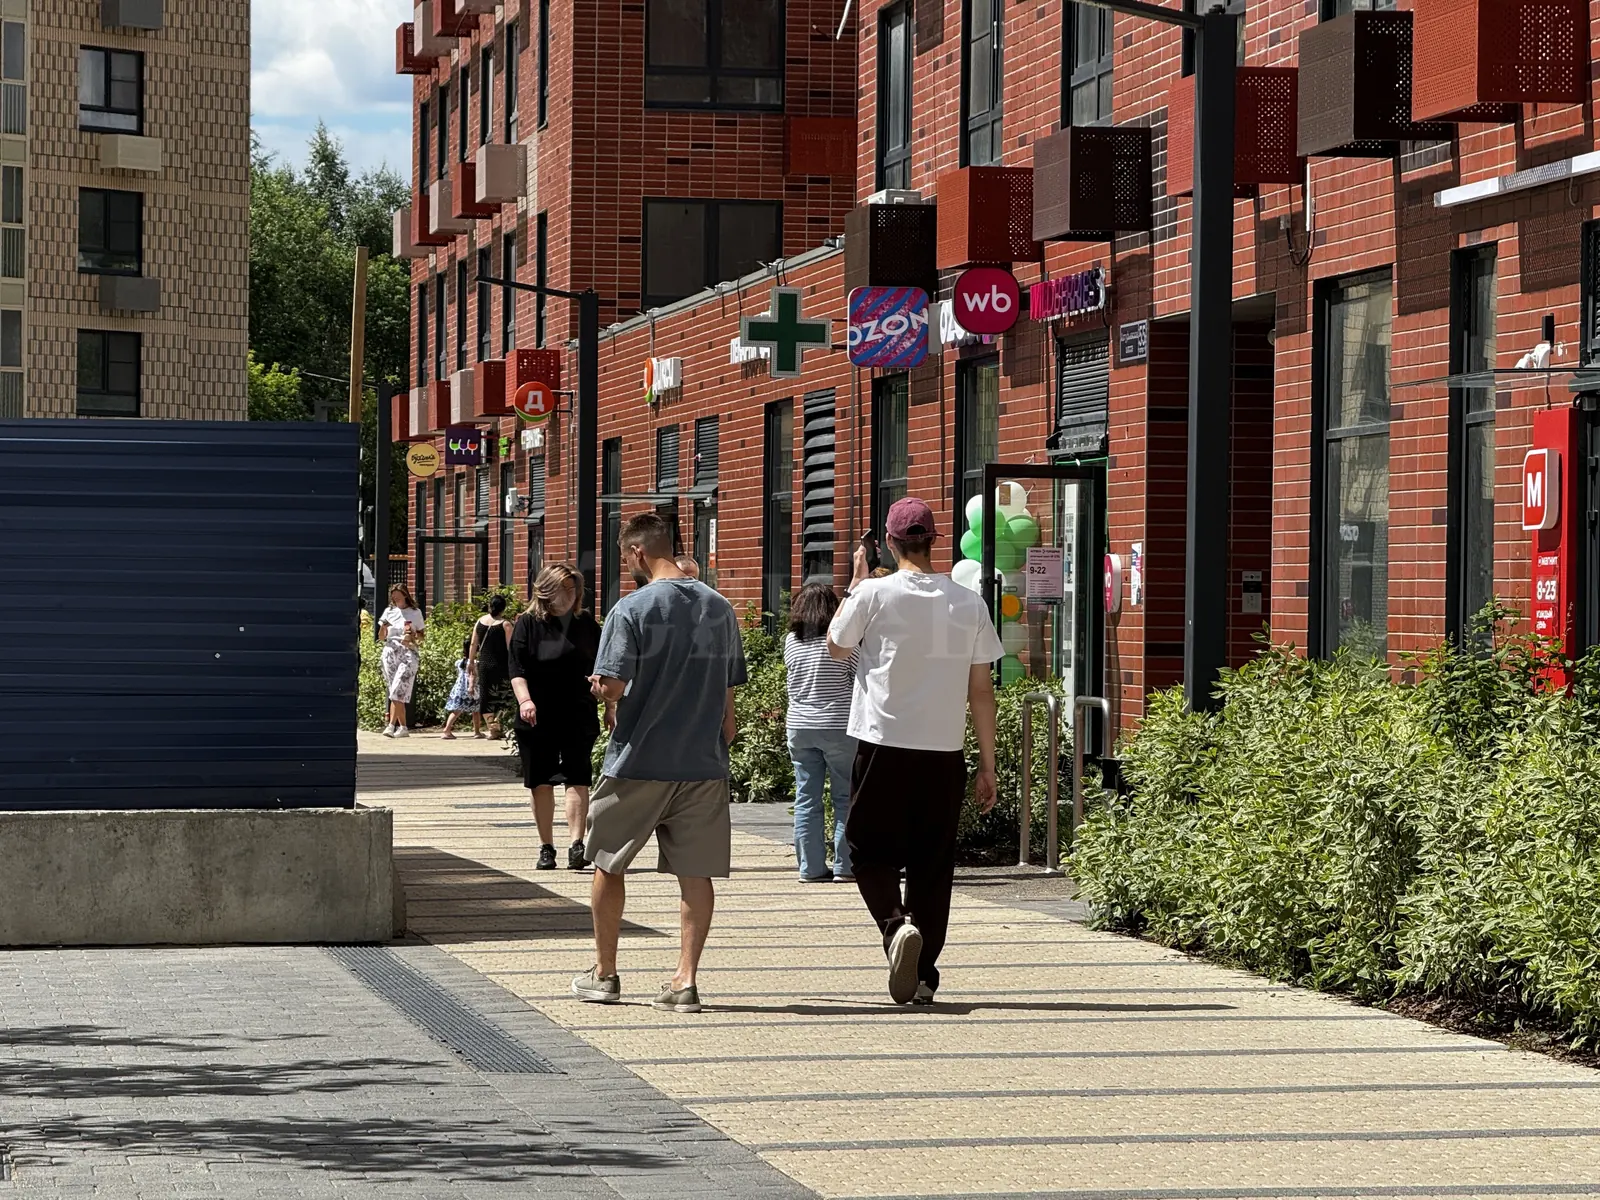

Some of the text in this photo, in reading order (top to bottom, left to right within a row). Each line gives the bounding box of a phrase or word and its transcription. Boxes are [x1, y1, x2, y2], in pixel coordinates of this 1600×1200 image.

[962, 284, 1012, 313] wb
[524, 390, 545, 412] Д
[1029, 566, 1046, 575] 9-22
[1536, 580, 1557, 602] 8-23
